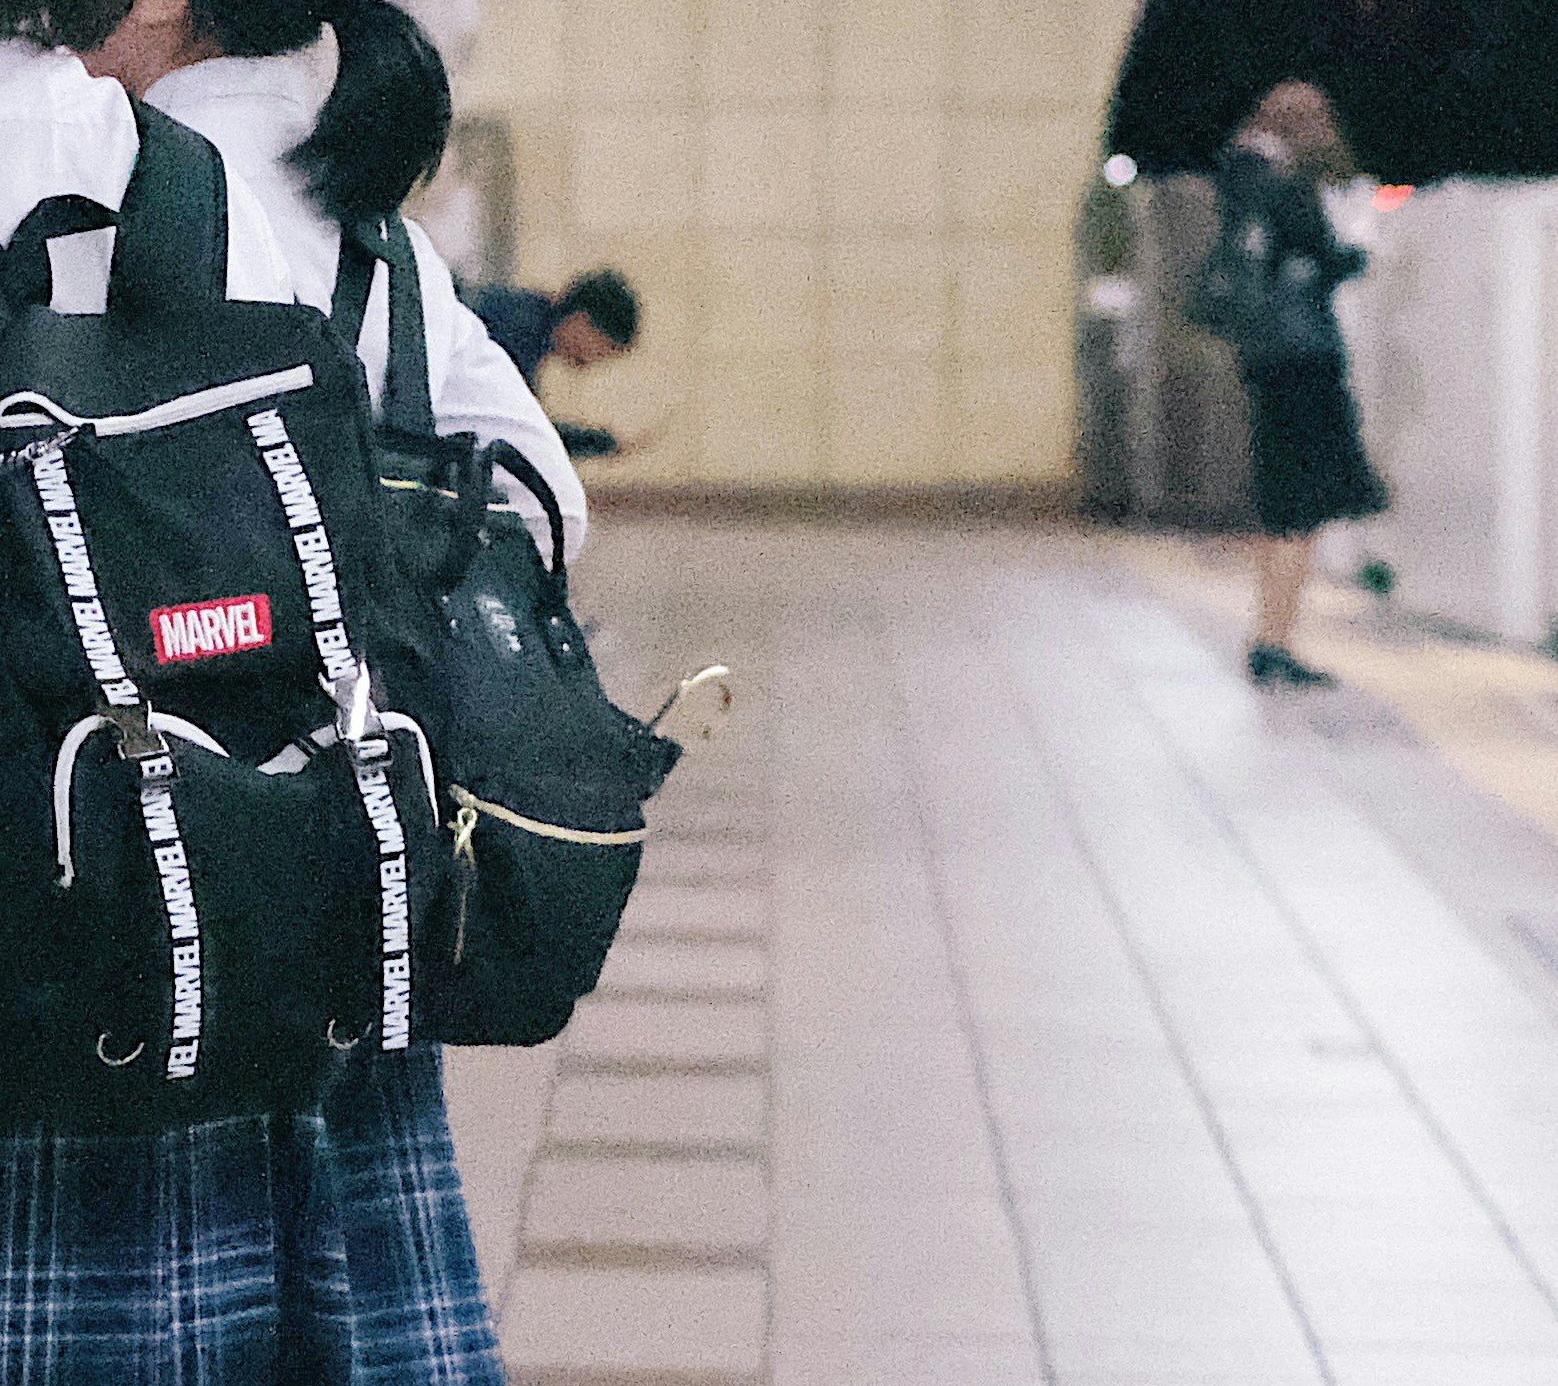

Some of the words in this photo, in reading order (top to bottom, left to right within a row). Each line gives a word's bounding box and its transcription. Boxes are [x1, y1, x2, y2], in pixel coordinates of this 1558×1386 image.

[262, 441, 322, 529] MARVEL
[47, 510, 99, 598] MARVEL
[293, 524, 342, 623] MARVEL
[71, 597, 127, 681] MARVEL
[158, 600, 265, 660] MARVEL
[153, 839, 200, 940] MARVEL
[380, 852, 410, 953] MARVEL
[173, 938, 203, 1040] MARVEL
[382, 951, 411, 1051] MARVEL
